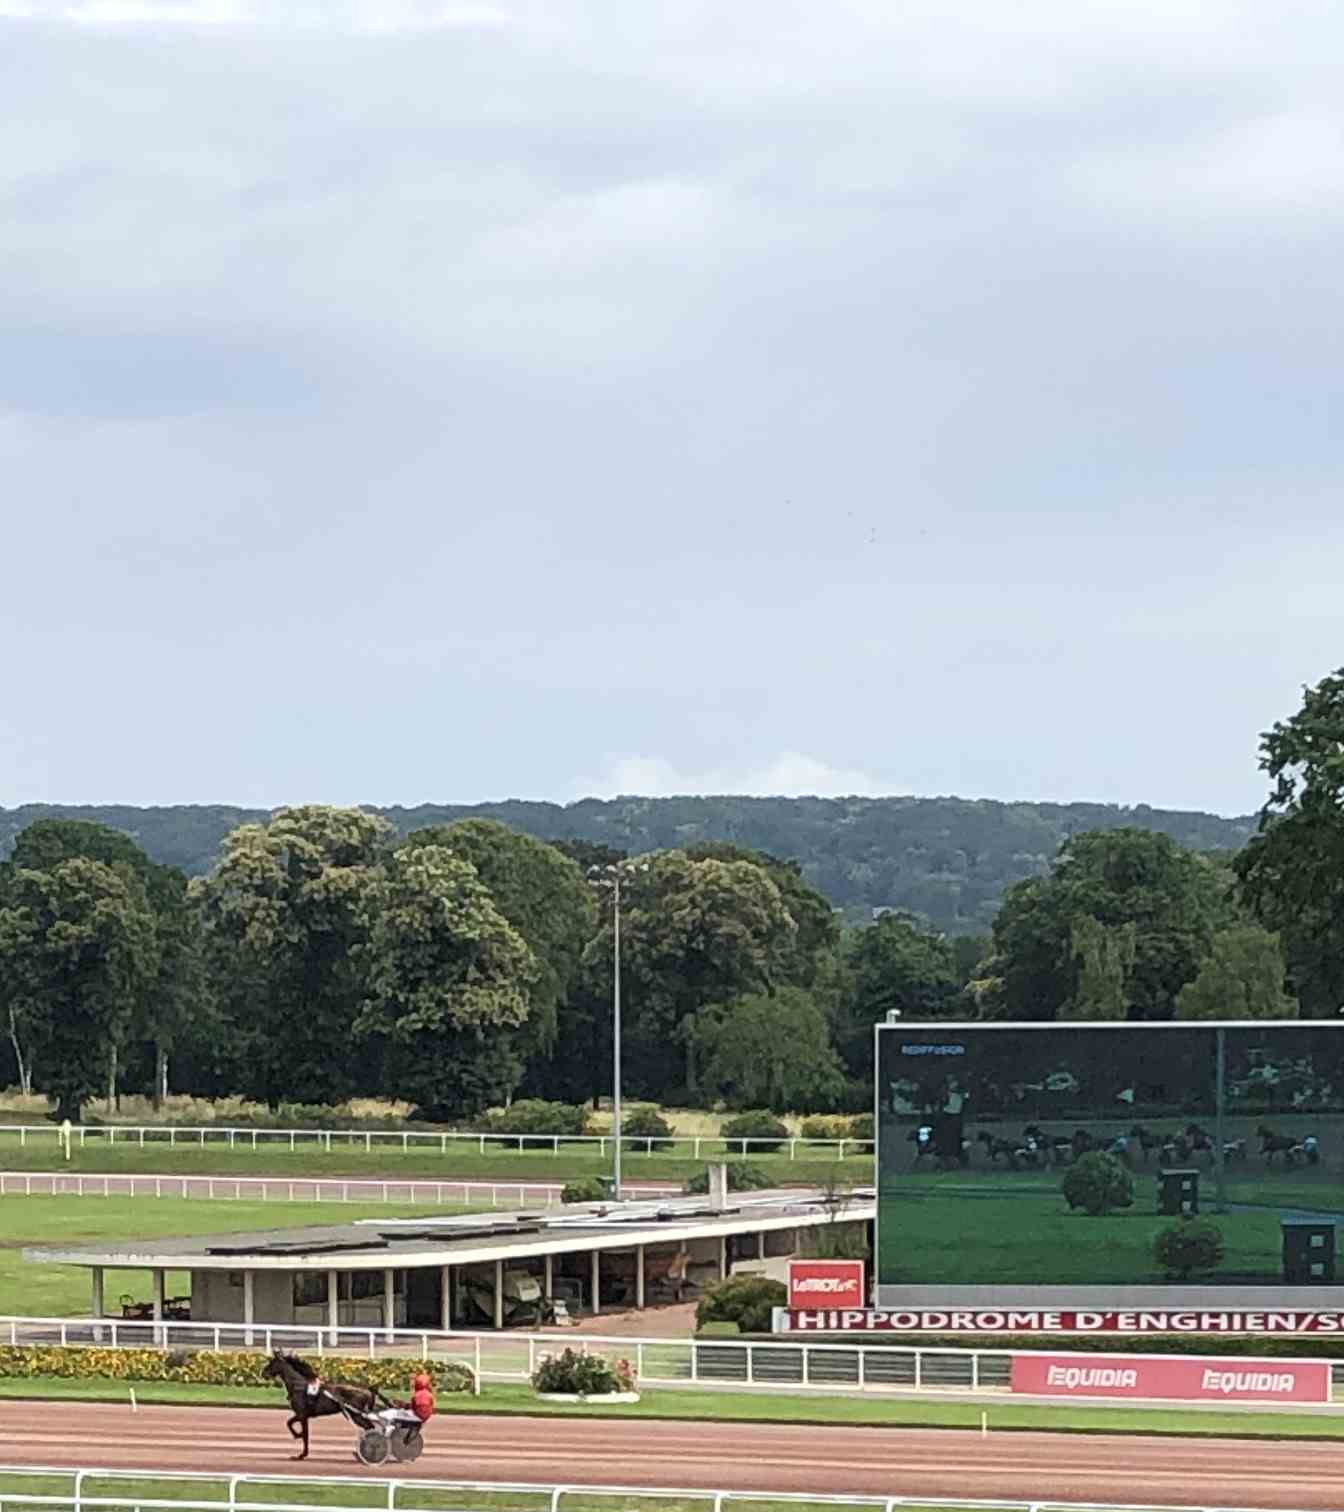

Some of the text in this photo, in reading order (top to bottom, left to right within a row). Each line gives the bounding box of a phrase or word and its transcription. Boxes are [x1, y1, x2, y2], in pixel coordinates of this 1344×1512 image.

[797, 1311, 1062, 1329] HIPPODROME
[1046, 1365, 1137, 1389] EQUIDIA
[1202, 1369, 1294, 1392] EQUIDIA
